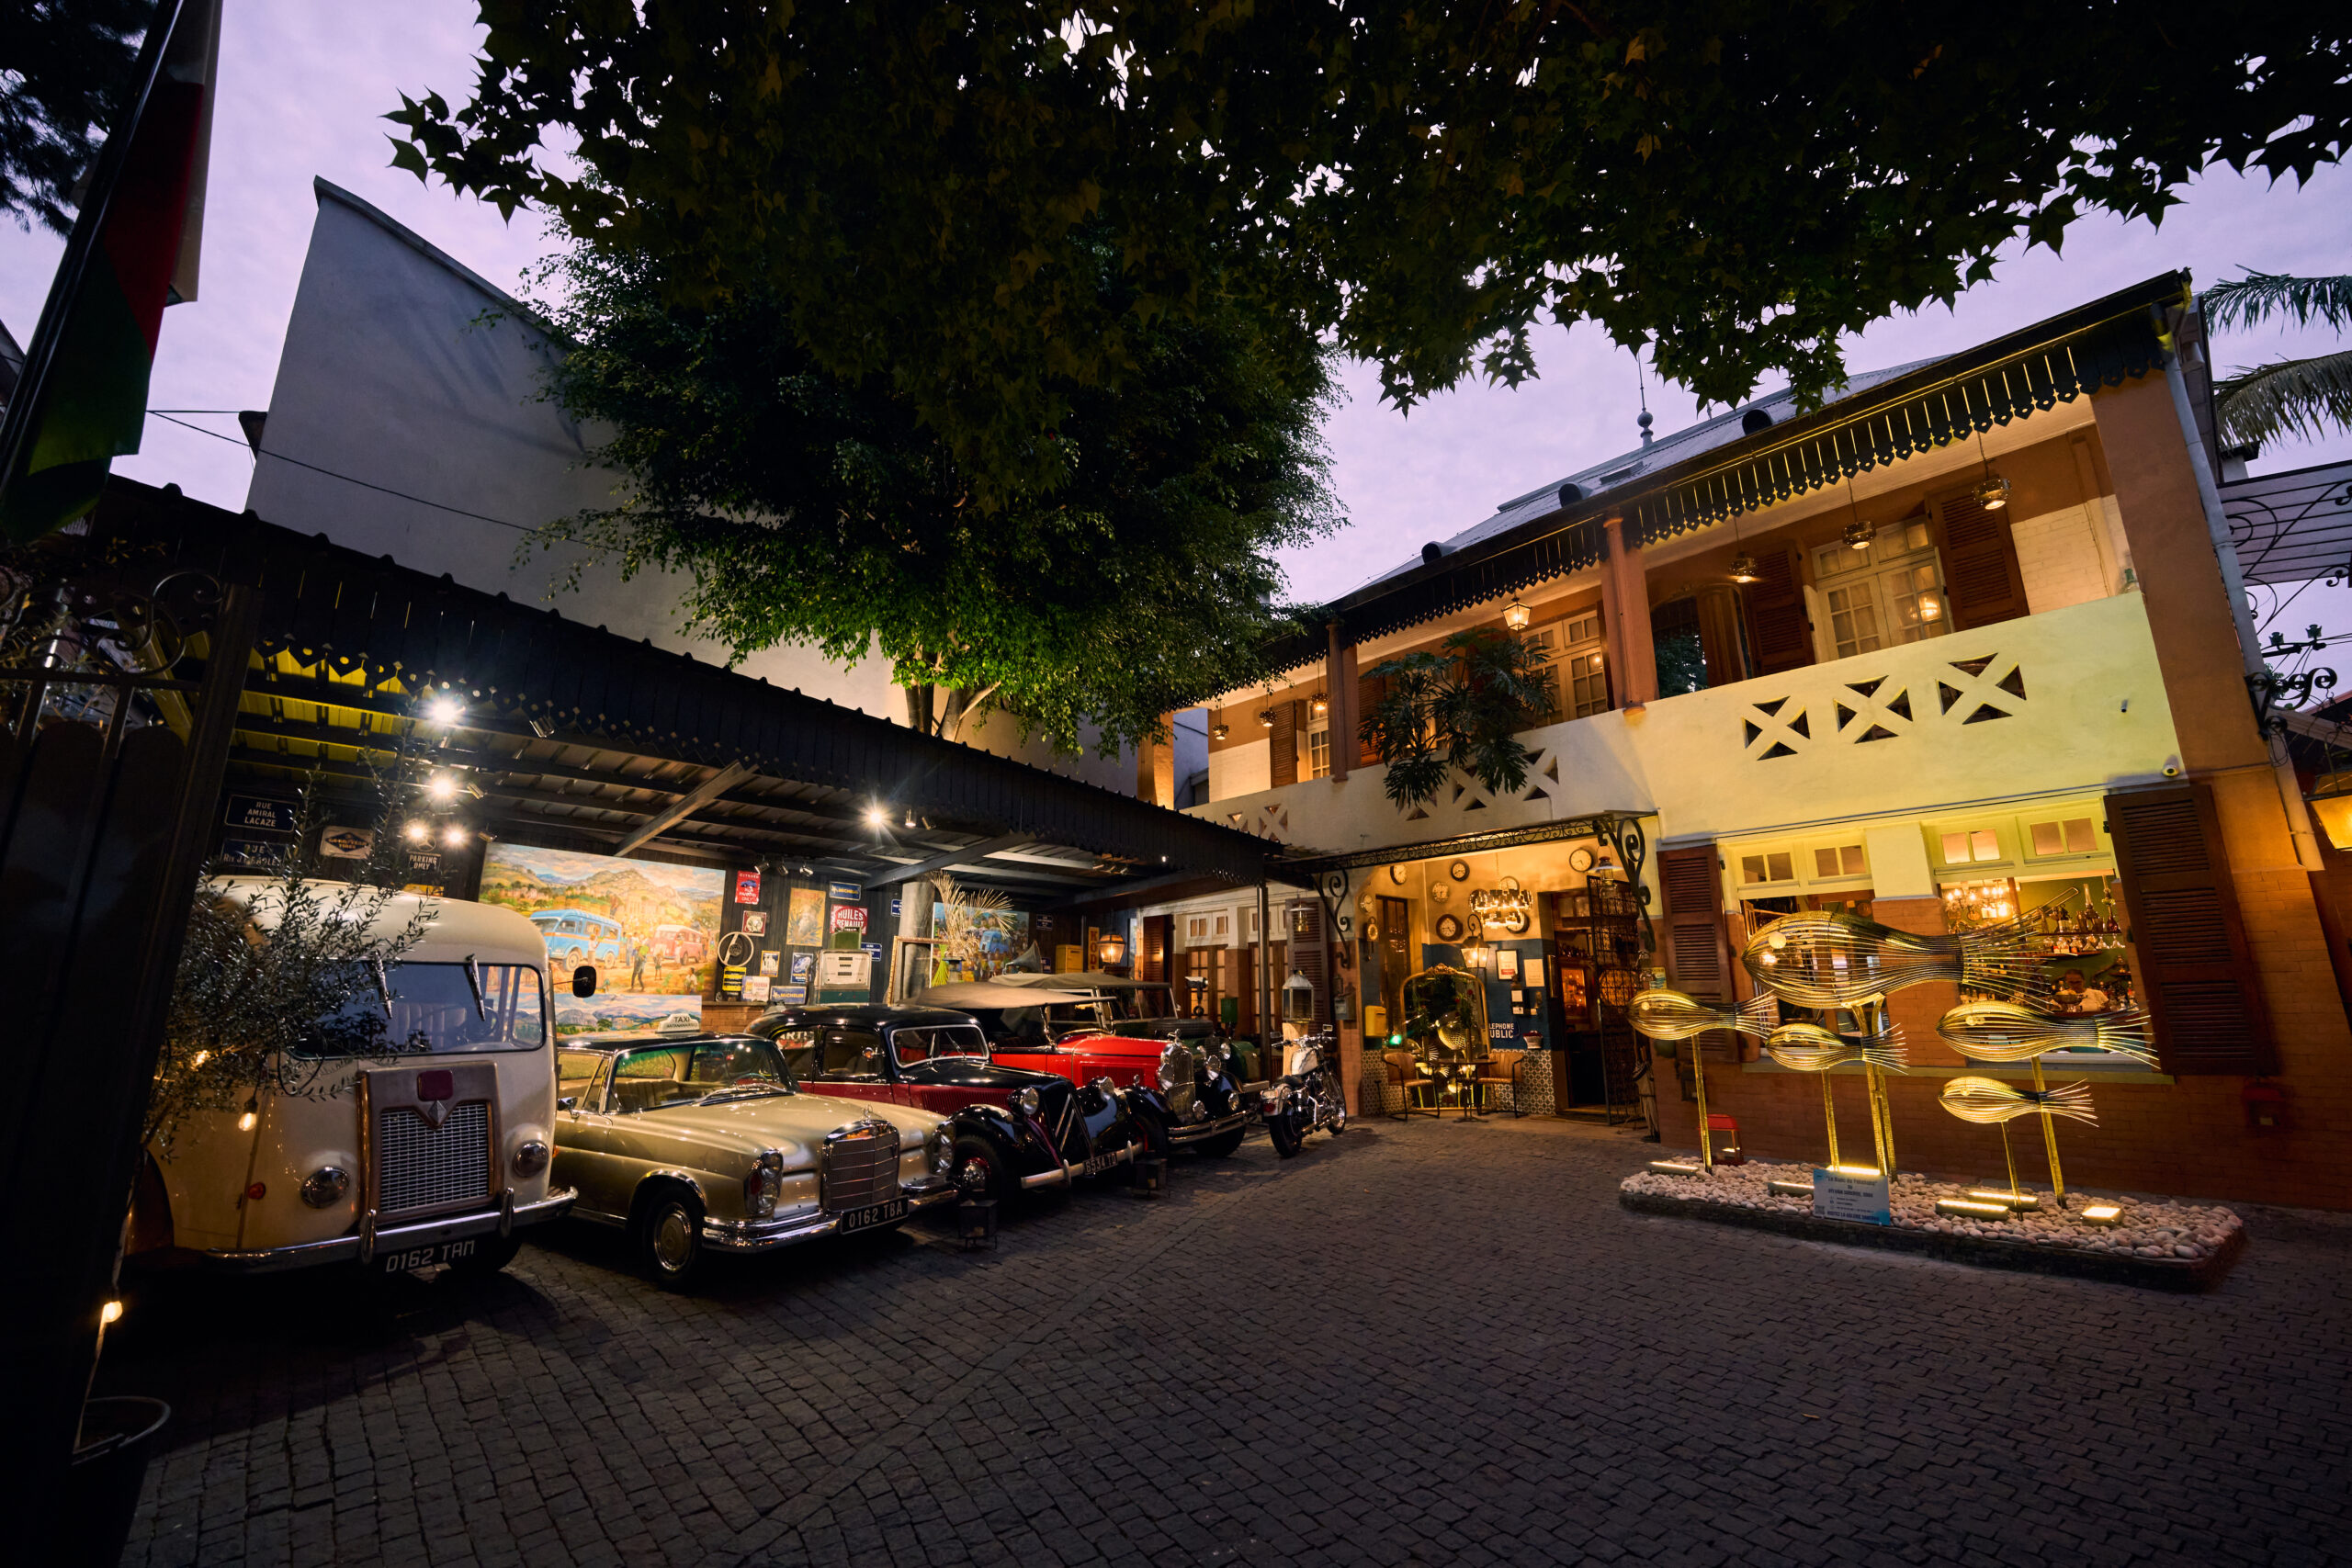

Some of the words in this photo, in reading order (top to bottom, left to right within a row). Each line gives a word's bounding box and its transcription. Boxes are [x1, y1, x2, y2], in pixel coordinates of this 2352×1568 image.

[247, 808, 276, 818] AMIRAL
[244, 816, 277, 827] LACAZE
[409, 854, 437, 864] PARKING
[413, 862, 431, 871] ONLY
[837, 908, 864, 920] HUILES
[836, 919, 864, 928] RENAULT
[1090, 931, 1098, 969] KOD
[1489, 1029, 1514, 1039] UBLIC
[849, 1207, 879, 1228] 0162
[883, 1201, 903, 1220] TBA
[386, 1247, 435, 1273] 0162
[441, 1240, 476, 1261] TAM
